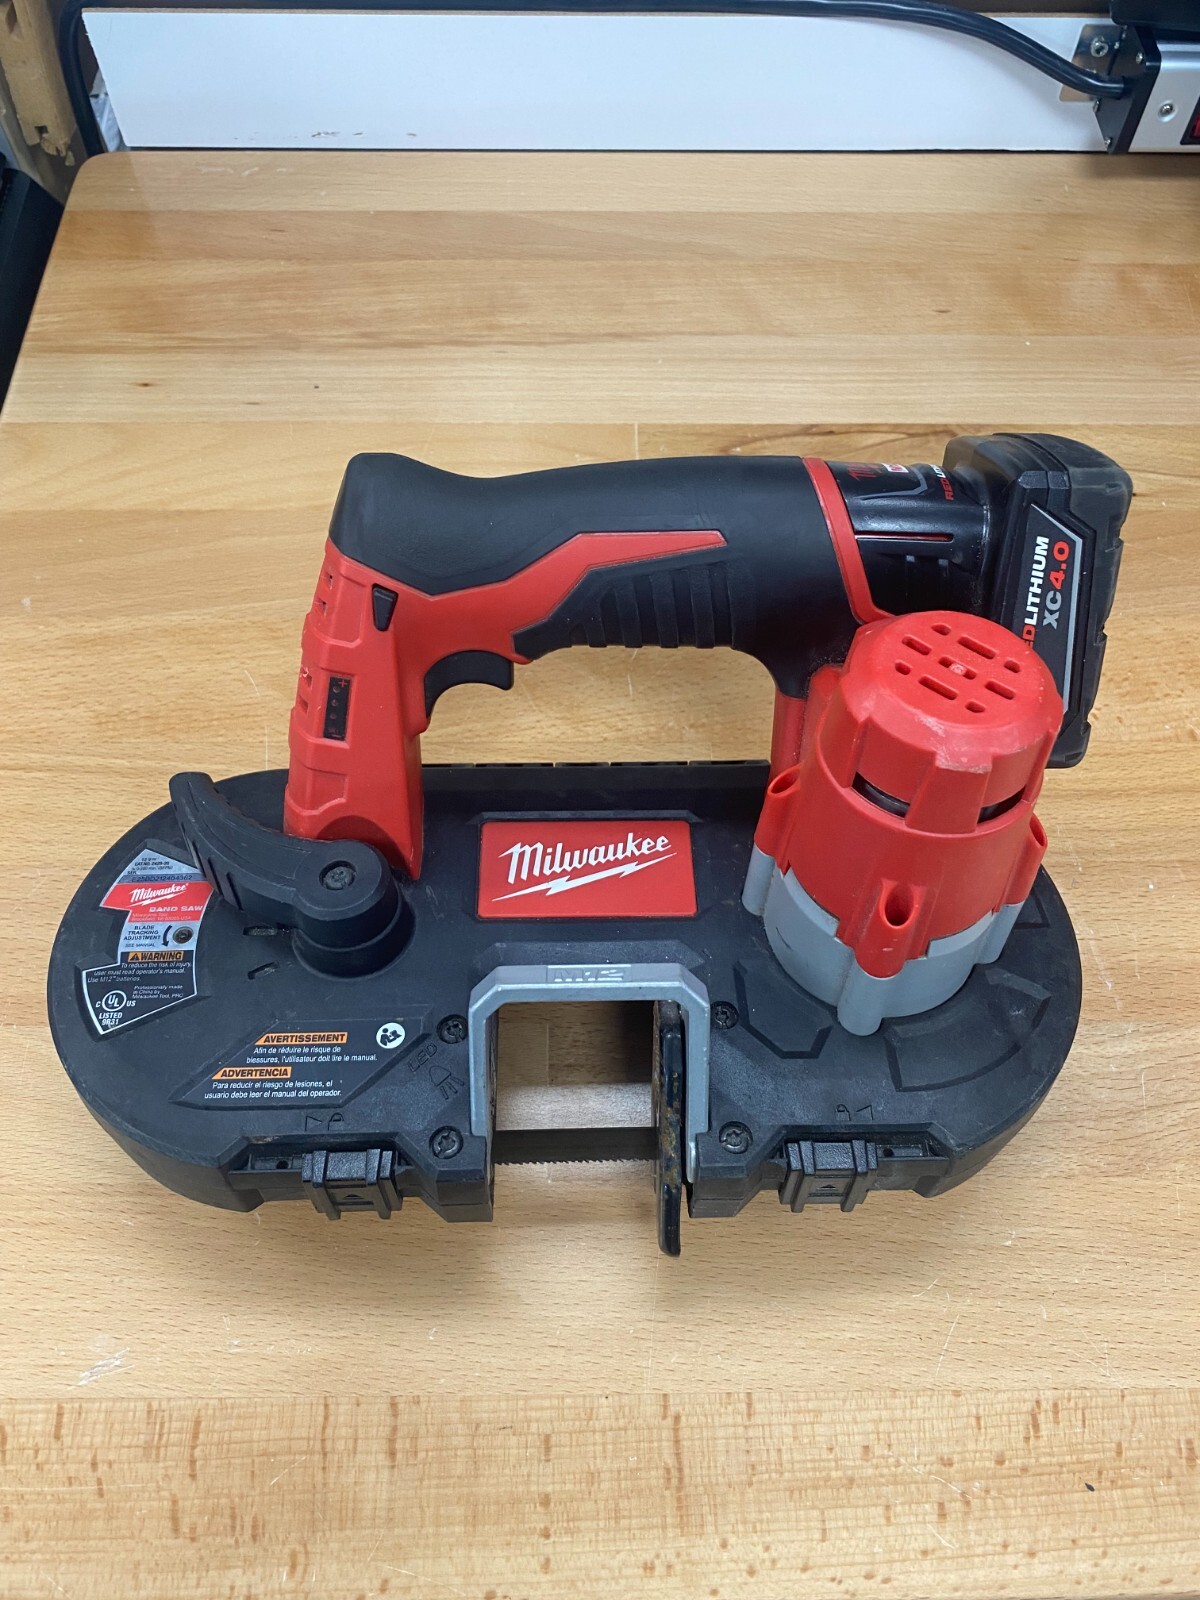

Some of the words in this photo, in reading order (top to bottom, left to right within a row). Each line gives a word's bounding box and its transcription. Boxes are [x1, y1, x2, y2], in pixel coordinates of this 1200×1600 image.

[498, 832, 672, 884] Milwaukee
[129, 884, 187, 902] Milwaukee
[141, 952, 182, 960] WARNING
[263, 1034, 345, 1043] AVERTISSEMENT
[310, 1046, 331, 1054] risque
[332, 1045, 341, 1053] de
[408, 1043, 437, 1073] LED
[220, 1068, 289, 1078] ADVERTENCIA
[230, 1081, 253, 1089] reducir
[262, 1081, 284, 1090] riesgo
[284, 1080, 294, 1088] de
[326, 1079, 333, 1087] el
[204, 1091, 229, 1099] usuario
[264, 1090, 271, 1098] el
[271, 1090, 296, 1098] manual
[310, 1089, 342, 1098] operador.
